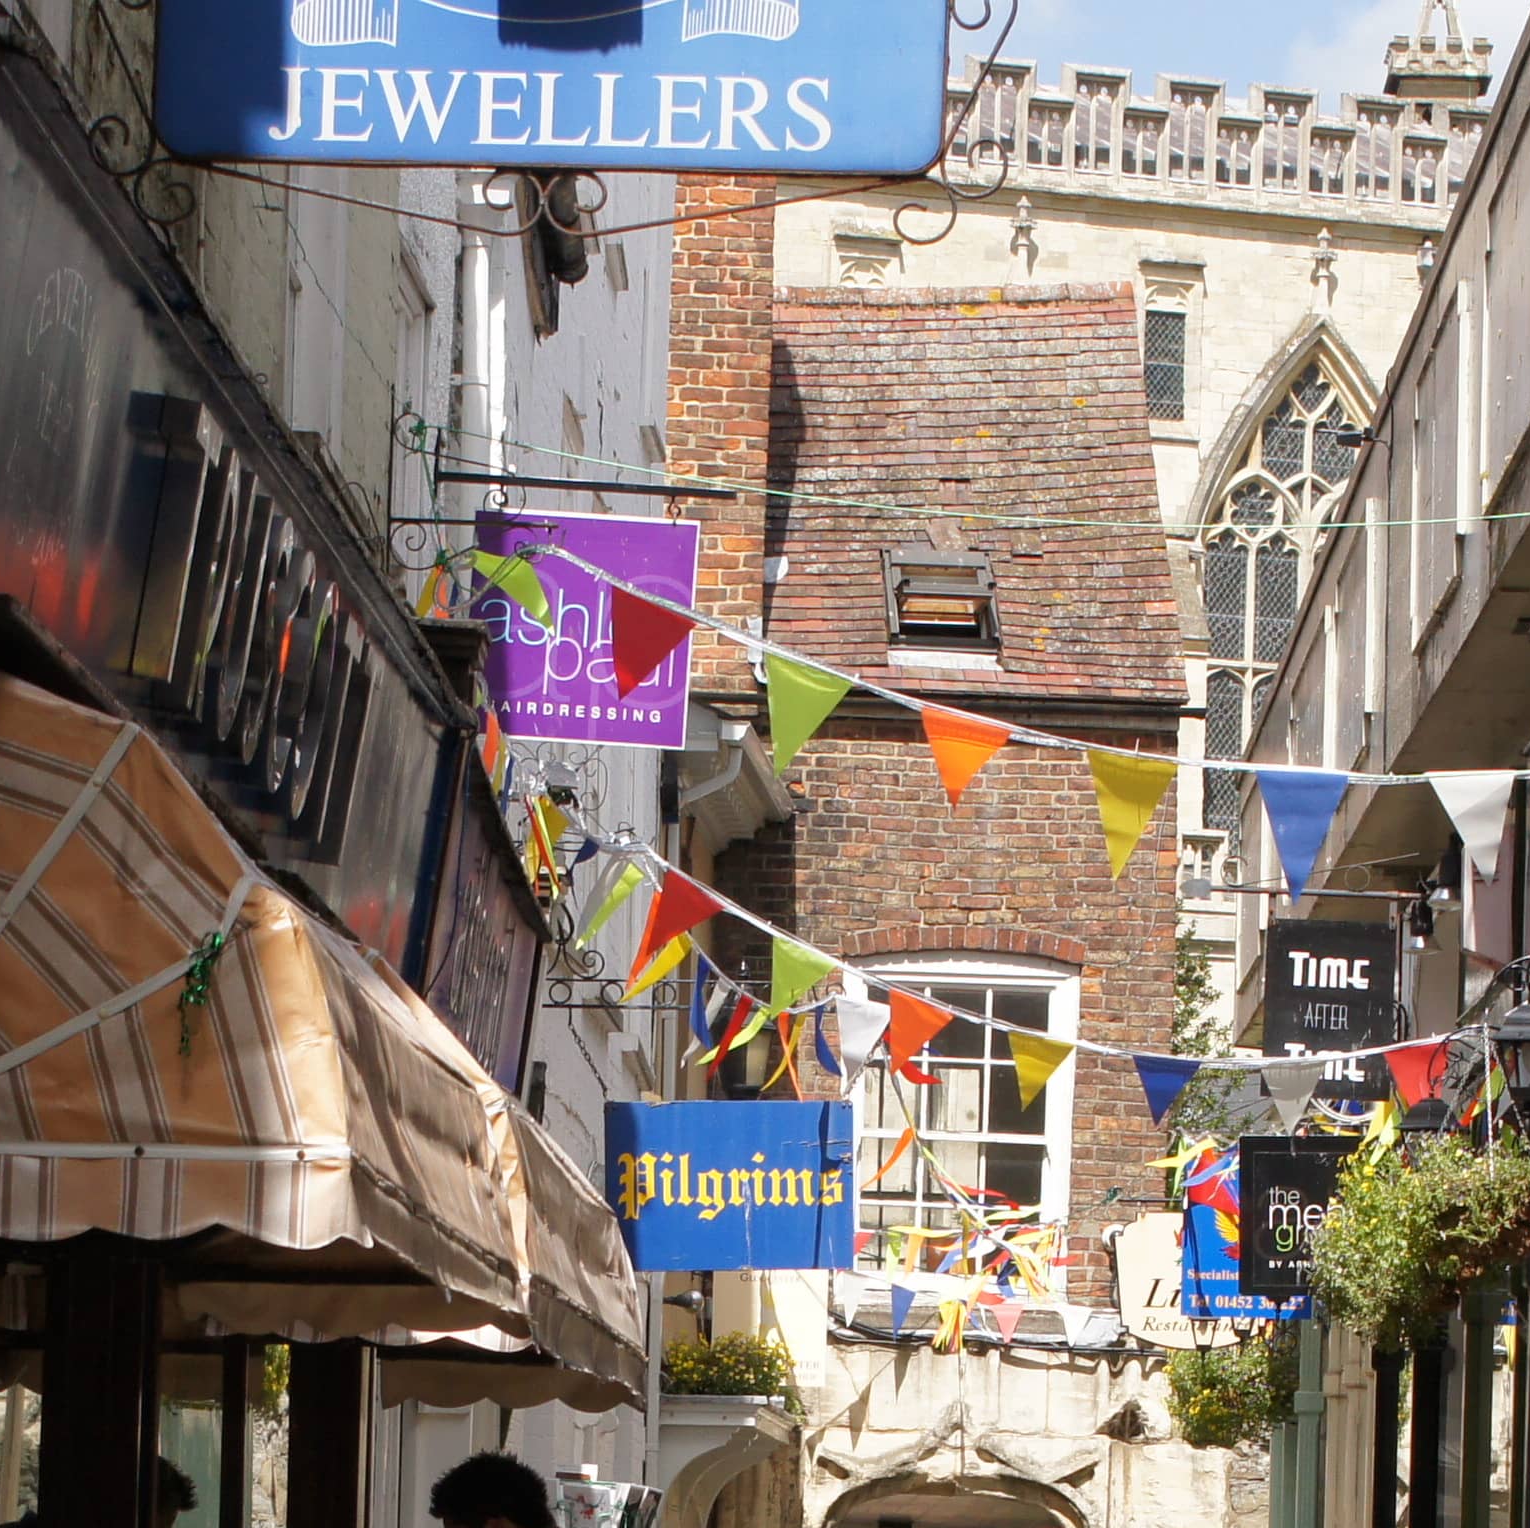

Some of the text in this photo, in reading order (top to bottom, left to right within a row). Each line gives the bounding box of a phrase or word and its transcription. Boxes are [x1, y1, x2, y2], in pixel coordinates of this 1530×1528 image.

[269, 67, 831, 152] JEWELLERS
[491, 700, 663, 723] AIRDRESSING
[1303, 1002, 1349, 1030] AFTER
[617, 1152, 845, 1221] Pilgrims
[1268, 1186, 1301, 1205] the
[1215, 1295, 1253, 1309] 01452
